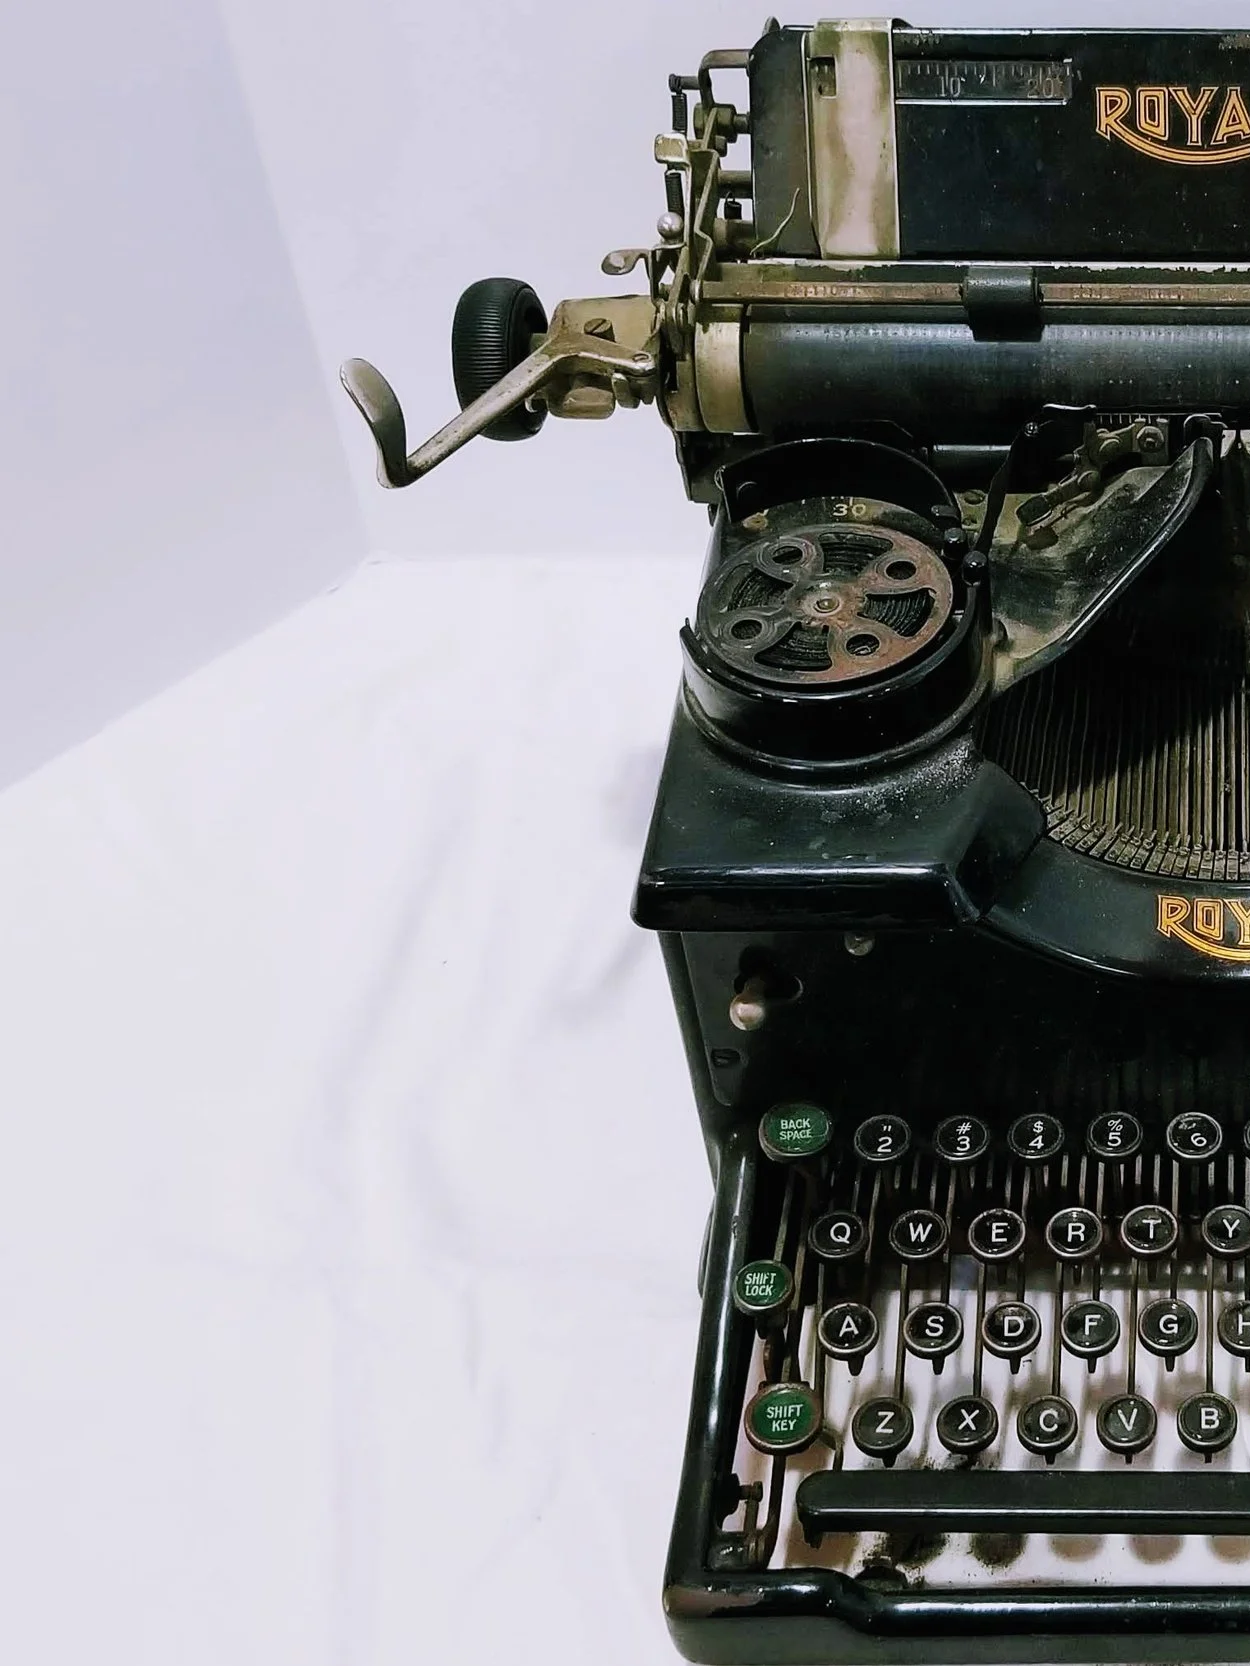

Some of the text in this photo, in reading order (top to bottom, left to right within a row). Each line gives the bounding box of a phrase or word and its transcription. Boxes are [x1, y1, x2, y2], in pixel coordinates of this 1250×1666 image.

[938, 76, 1054, 98] 10 20
[832, 503, 867, 517] 30
[780, 1118, 811, 1130] BACK
[1033, 1121, 1043, 1133] $
[1108, 1119, 1123, 1133] %
[779, 1129, 812, 1141] SPACE
[877, 1137, 892, 1152] 2
[957, 1136, 970, 1151] 3
[1028, 1135, 1044, 1149] 4
[1107, 1132, 1122, 1147] 5
[1191, 1133, 1207, 1146] 6
[830, 1223, 850, 1243] Q
[909, 1223, 932, 1242] W
[992, 1223, 1010, 1242] E
[1067, 1222, 1085, 1242] R
[1142, 1218, 1162, 1239] T
[1222, 1218, 1241, 1239] Y
[745, 1273, 776, 1286] SHIFT
[745, 1283, 773, 1296] LOCK
[839, 1315, 859, 1337] A
[926, 1316, 944, 1336] S
[1003, 1315, 1025, 1337] D
[1084, 1314, 1101, 1336] F
[1159, 1314, 1179, 1335] G
[766, 1404, 803, 1419] SHIFT
[959, 1409, 979, 1430] X
[1039, 1409, 1059, 1432] C
[1118, 1408, 1137, 1431] V
[1200, 1407, 1220, 1430] B
[771, 1419, 797, 1432] KEY
[876, 1412, 894, 1433] Z
